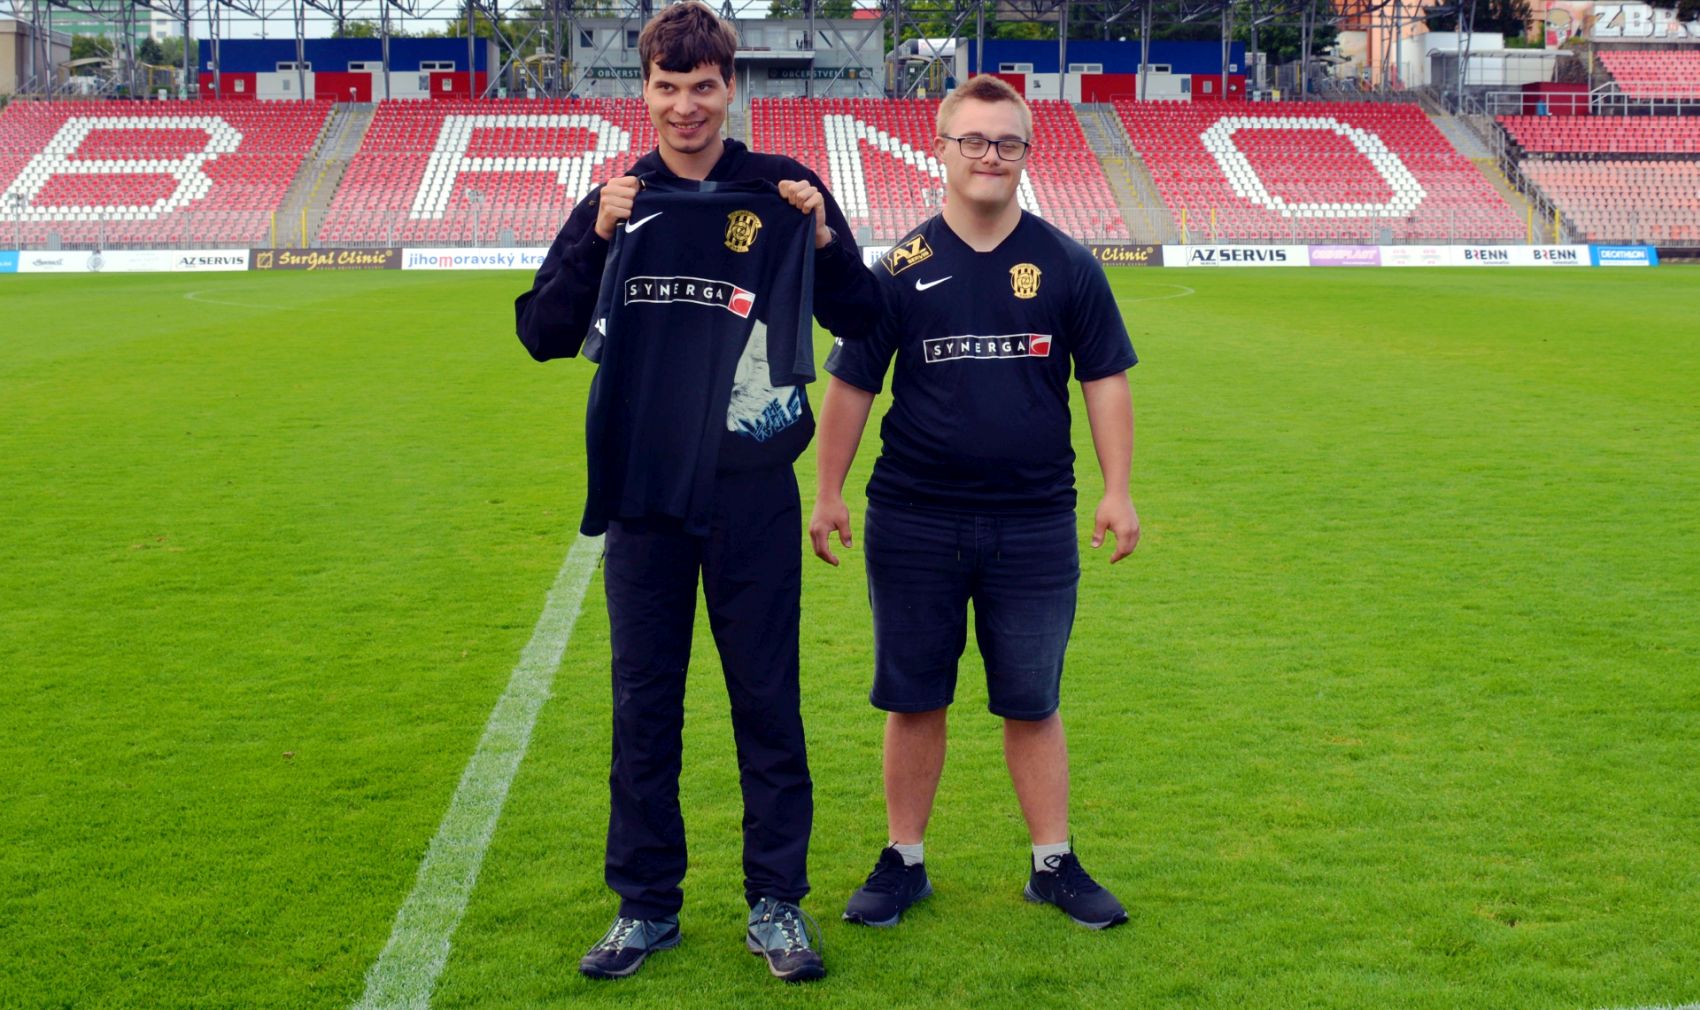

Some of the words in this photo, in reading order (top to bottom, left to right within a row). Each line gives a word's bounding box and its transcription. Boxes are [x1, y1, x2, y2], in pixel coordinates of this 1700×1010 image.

[1593, 3, 1700, 38] ZBR
[893, 236, 926, 267] AZ
[1191, 248, 1217, 261] AZ
[1219, 248, 1287, 262] SERVIS
[1464, 249, 1509, 260] BRENN
[1533, 249, 1577, 260] BRENN
[180, 256, 197, 265] AZ
[199, 256, 245, 265] SERVIS
[408, 252, 515, 268] jihomoravský
[521, 252, 546, 265] kra
[628, 282, 724, 301] SYNERGA
[933, 341, 1026, 356] SYNERGA
